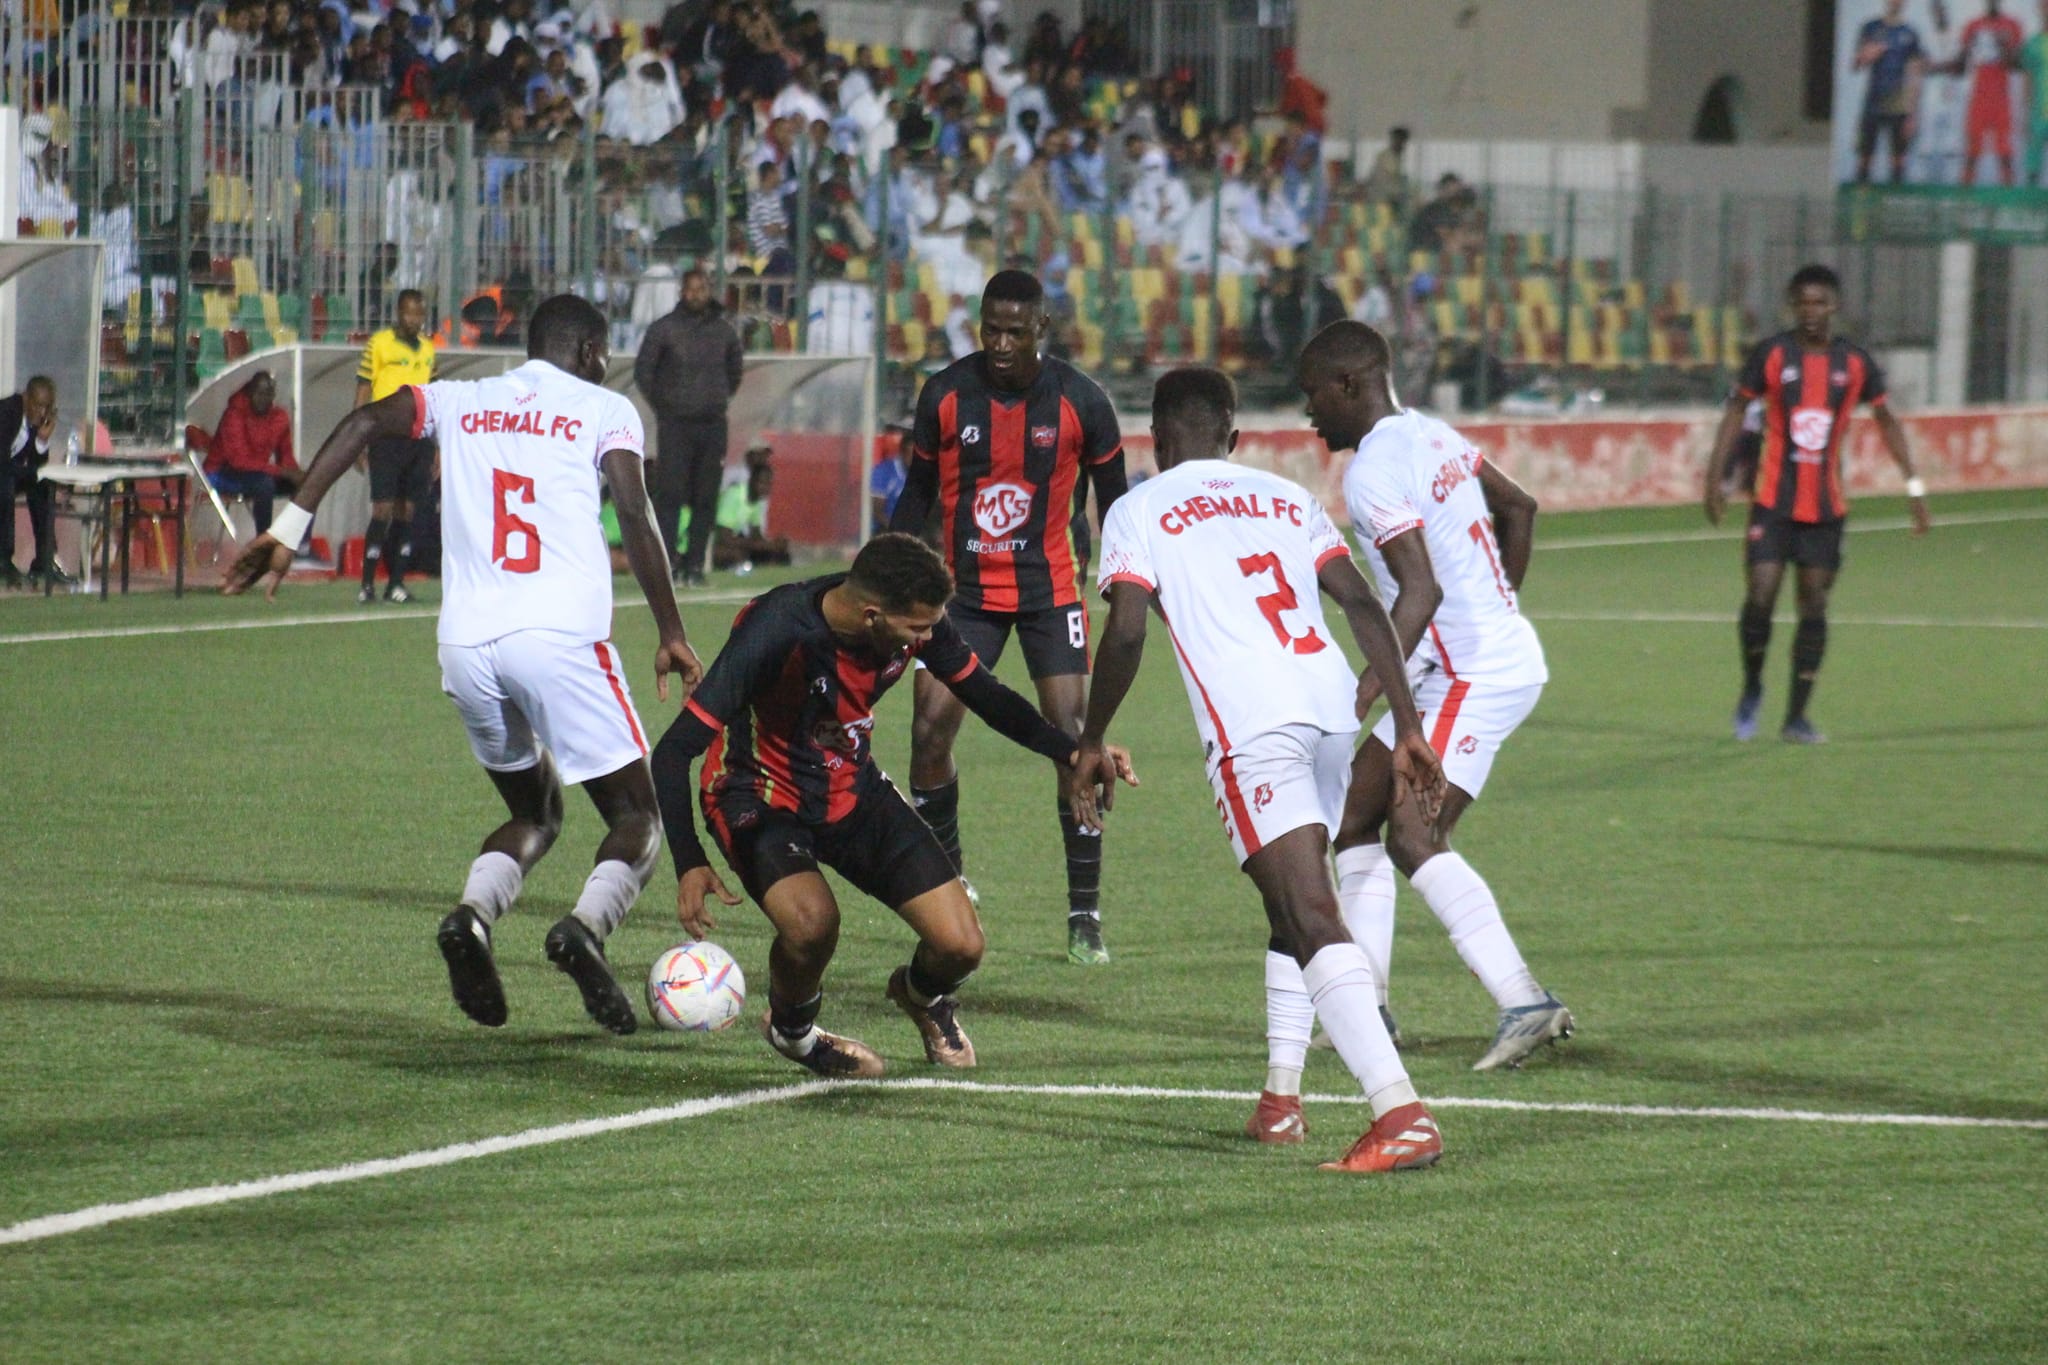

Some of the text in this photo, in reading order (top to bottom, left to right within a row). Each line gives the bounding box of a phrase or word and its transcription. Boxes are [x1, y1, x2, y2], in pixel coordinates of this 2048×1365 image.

[461, 411, 582, 441] CHEMAL FC
[492, 468, 541, 573] 6
[976, 490, 1030, 529] MSS
[1160, 494, 1302, 535] CHEMAL FC
[966, 539, 1027, 554] SECURITY
[1237, 551, 1327, 653] 2
[1067, 611, 1085, 649] 8
